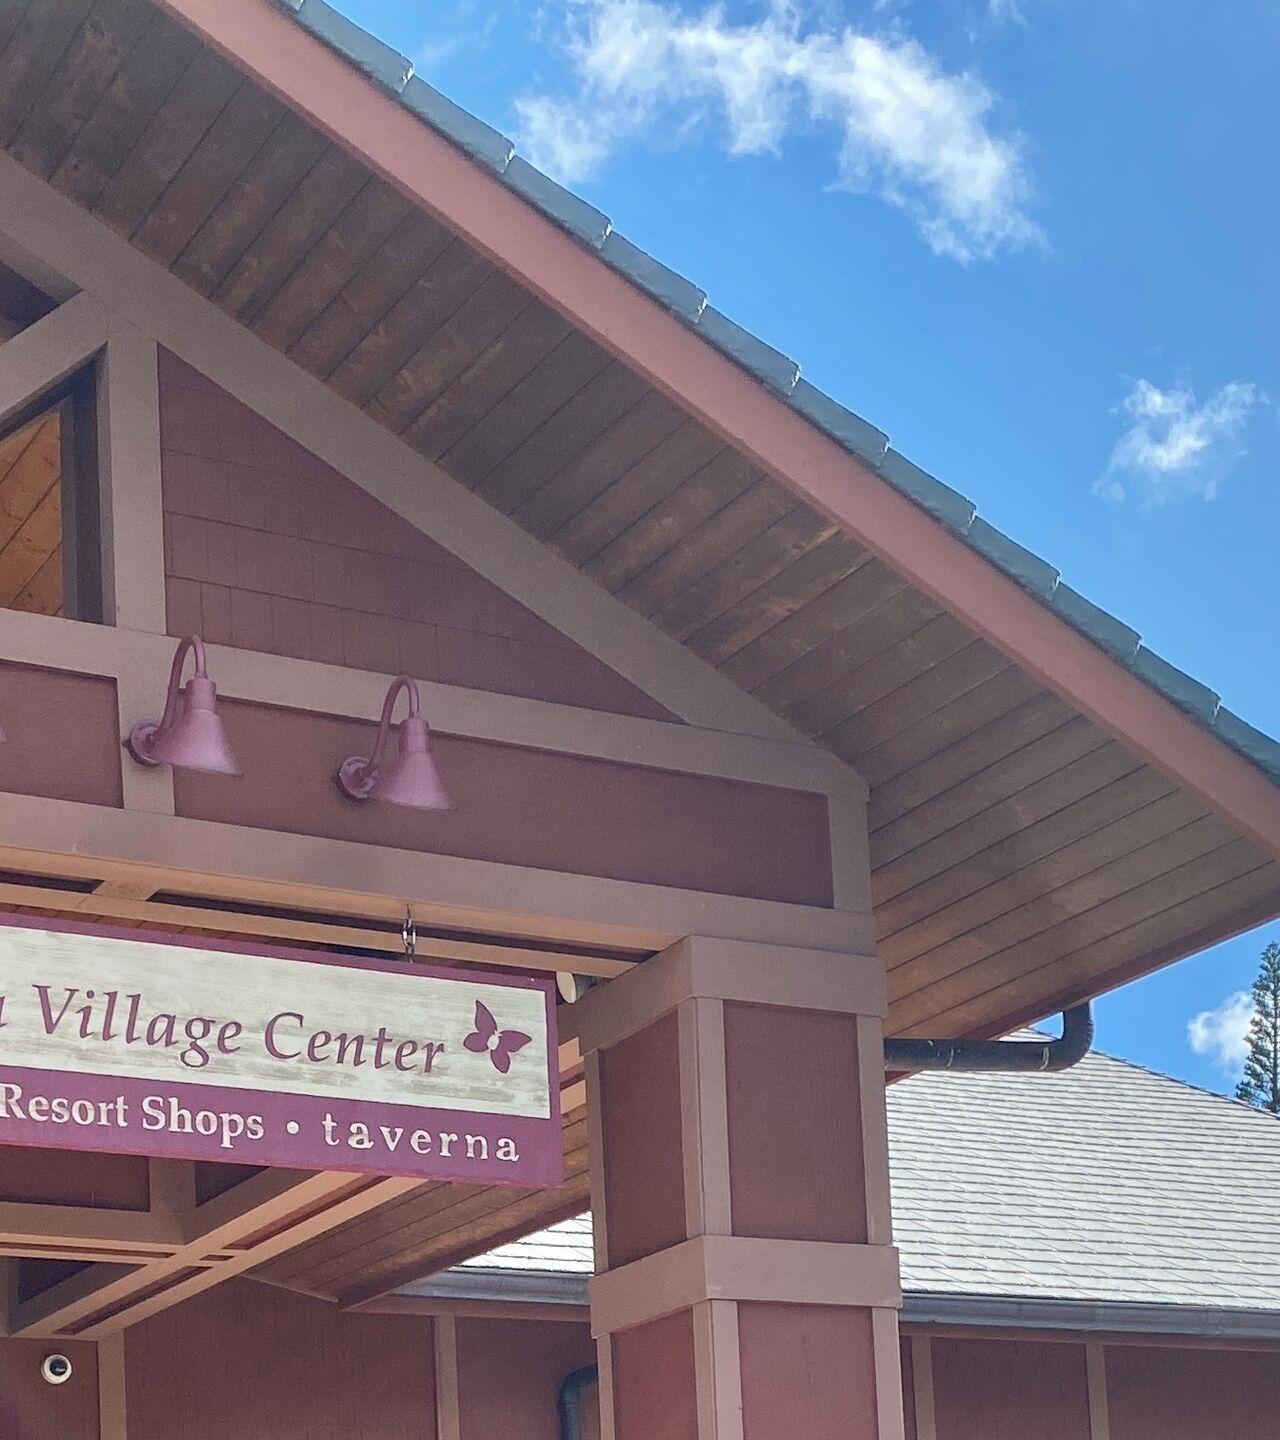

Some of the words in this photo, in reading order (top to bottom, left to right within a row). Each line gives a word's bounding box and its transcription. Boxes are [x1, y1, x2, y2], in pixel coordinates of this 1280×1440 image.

[32, 983, 242, 1069] Village
[263, 1011, 445, 1073] Center
[141, 1095, 265, 1149] Shops
[321, 1112, 520, 1163] taverna
